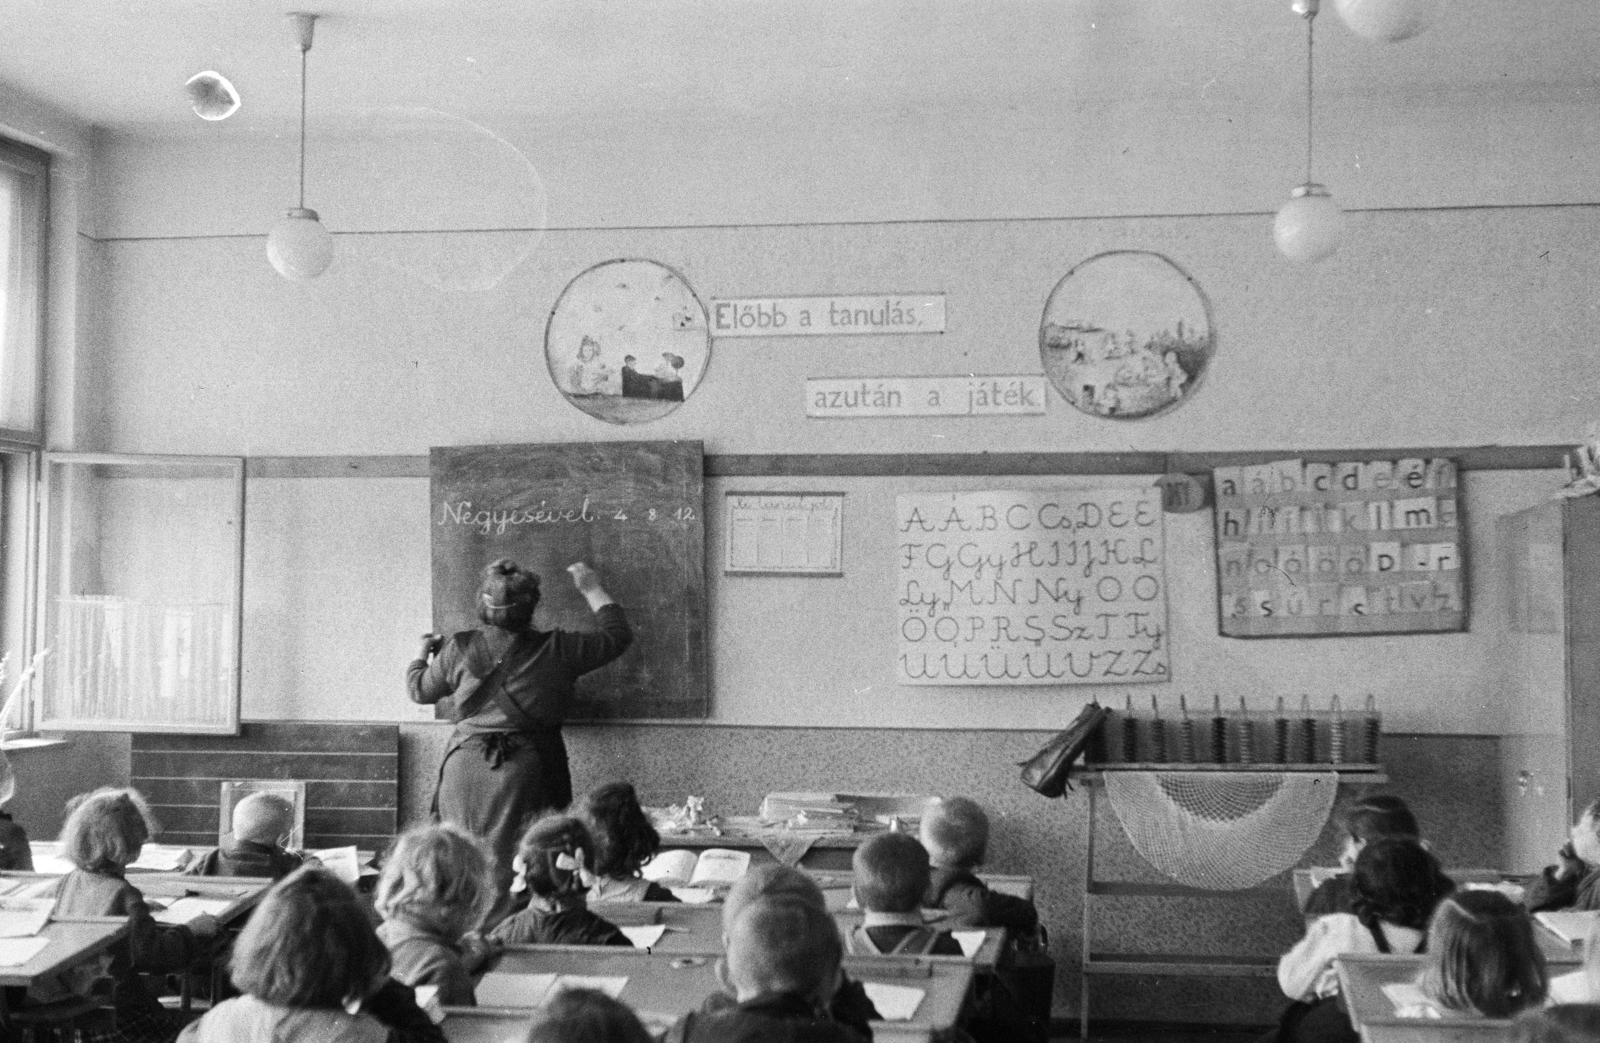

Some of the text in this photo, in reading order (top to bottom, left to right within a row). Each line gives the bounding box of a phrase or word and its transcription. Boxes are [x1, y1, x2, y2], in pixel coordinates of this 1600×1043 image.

[715, 299, 923, 329] Előbb a tanulás,
[814, 383, 902, 409] azután
[927, 389, 941, 407] a
[613, 508, 629, 521] 4
[648, 508, 657, 521] 8
[673, 506, 696, 520] 12
